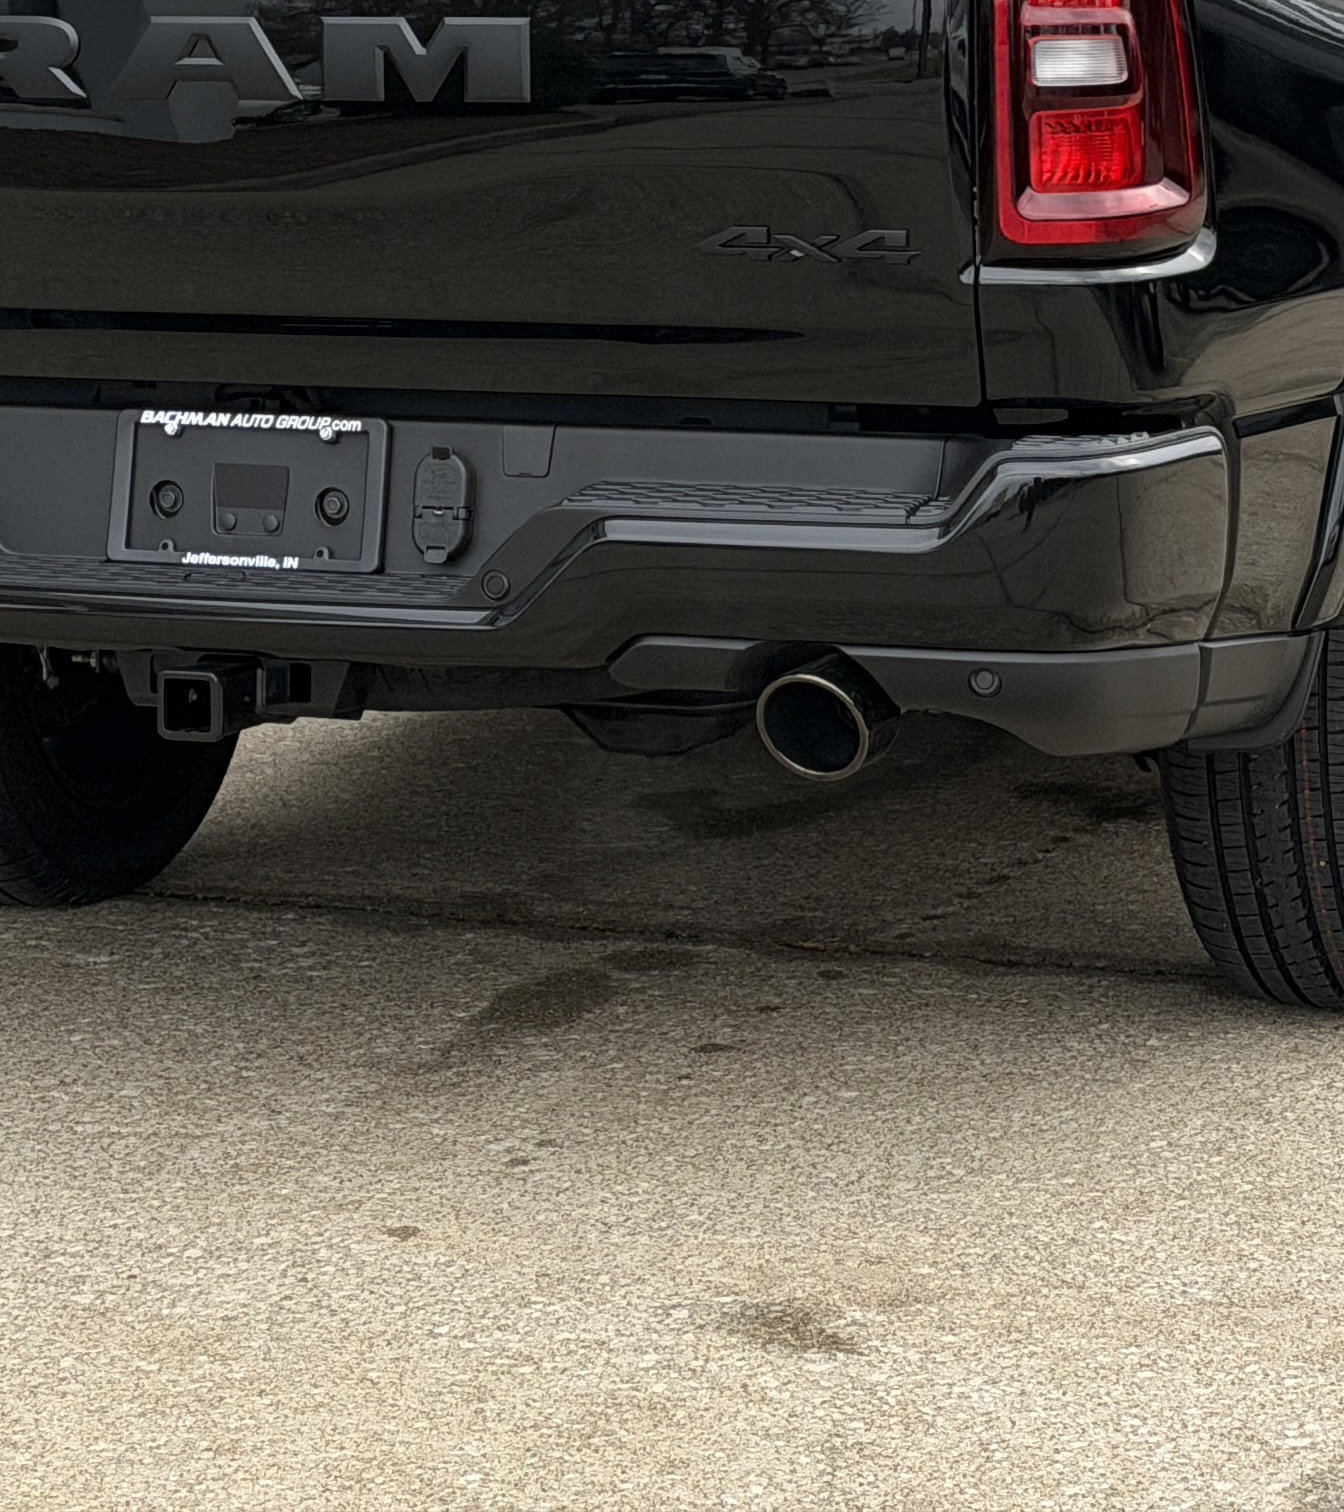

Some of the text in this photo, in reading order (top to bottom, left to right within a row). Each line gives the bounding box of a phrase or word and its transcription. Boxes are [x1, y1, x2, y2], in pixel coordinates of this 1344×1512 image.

[140, 410, 232, 427] BACHMAN
[230, 413, 275, 428] AUTO
[181, 552, 299, 570] Jeffersonville, IN
